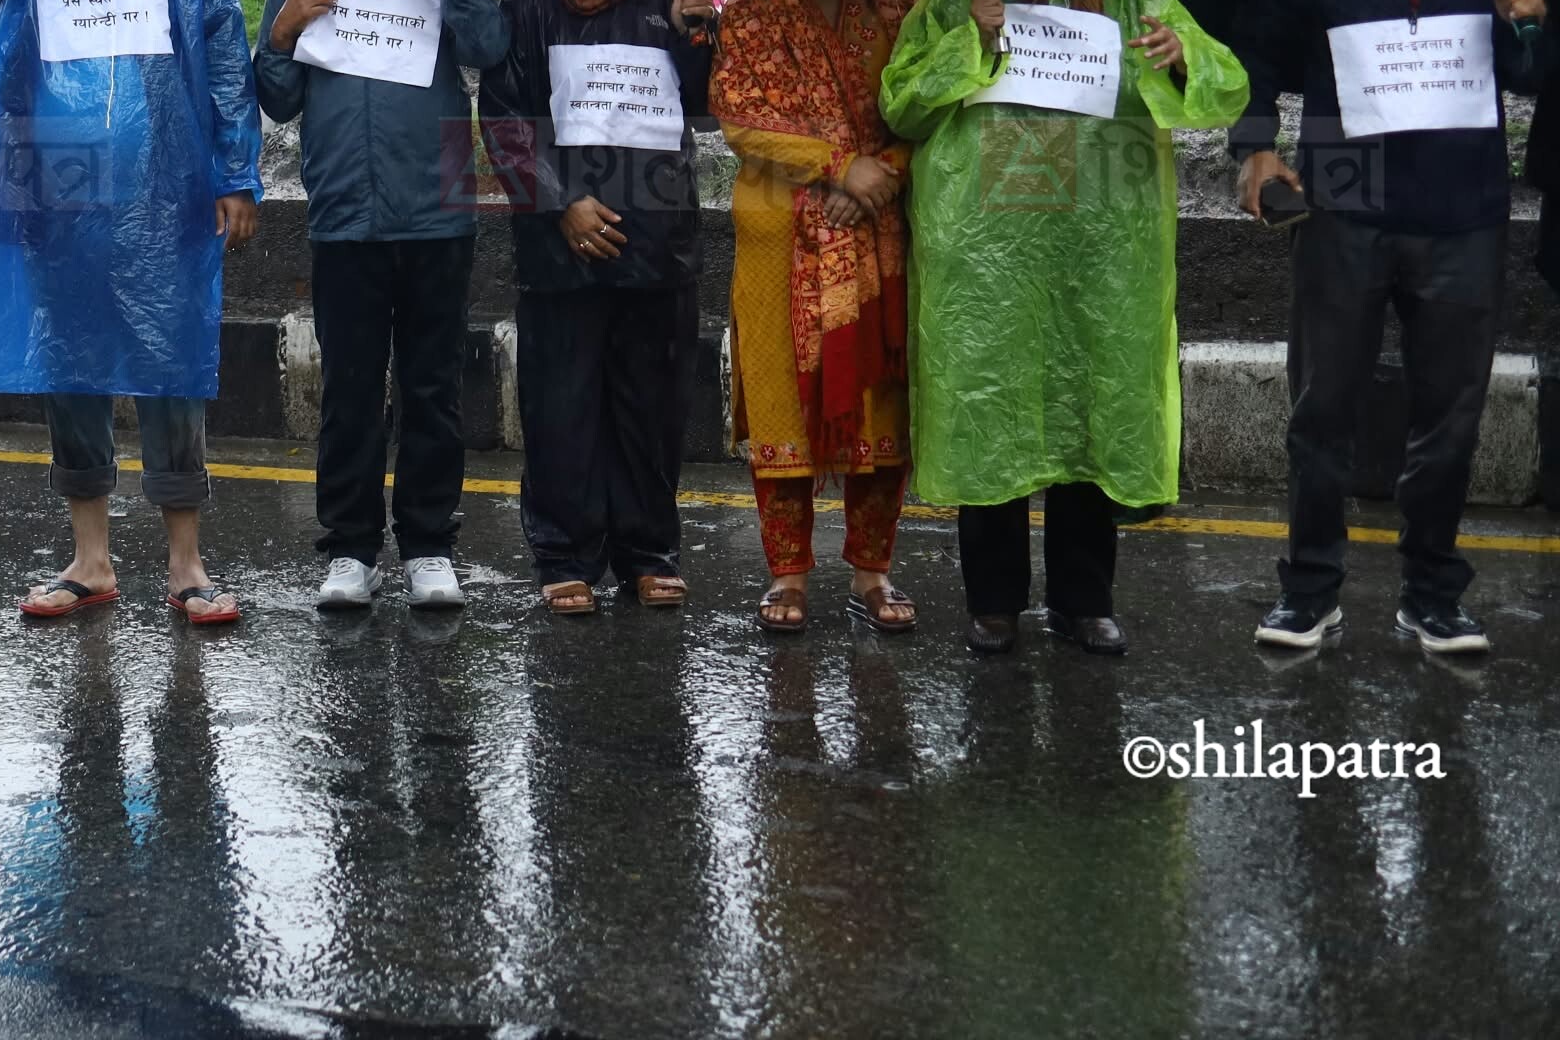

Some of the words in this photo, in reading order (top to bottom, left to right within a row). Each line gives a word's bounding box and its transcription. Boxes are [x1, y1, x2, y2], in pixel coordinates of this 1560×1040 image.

[72, 12, 117, 29] ग्यारेन्टी
[122, 11, 139, 24] गर
[355, 8, 427, 30] स्वतन्त्रताको
[335, 28, 379, 47] ग्यारेन्टी
[386, 36, 403, 50] गर
[1011, 23, 1037, 38] We
[1041, 25, 1089, 42] Want;
[1457, 38, 1465, 49] र
[1009, 46, 1073, 64] mocracy
[1079, 53, 1108, 65] and
[586, 61, 651, 77] संसद-इजलास
[654, 68, 662, 77] र
[1378, 61, 1424, 74] समाचार
[1431, 56, 1465, 70] कक्षको
[1005, 66, 1026, 77] ess
[1031, 67, 1096, 86] freedom
[586, 81, 625, 94] समाचार
[630, 82, 659, 97] कक्षको
[1362, 81, 1414, 97] स्वतन्त्रता
[1420, 80, 1457, 93] सम्मान
[1461, 79, 1475, 91] गर
[569, 100, 612, 112] स्वतन्त्रता
[617, 103, 647, 116] सम्मान
[652, 107, 666, 116] गर
